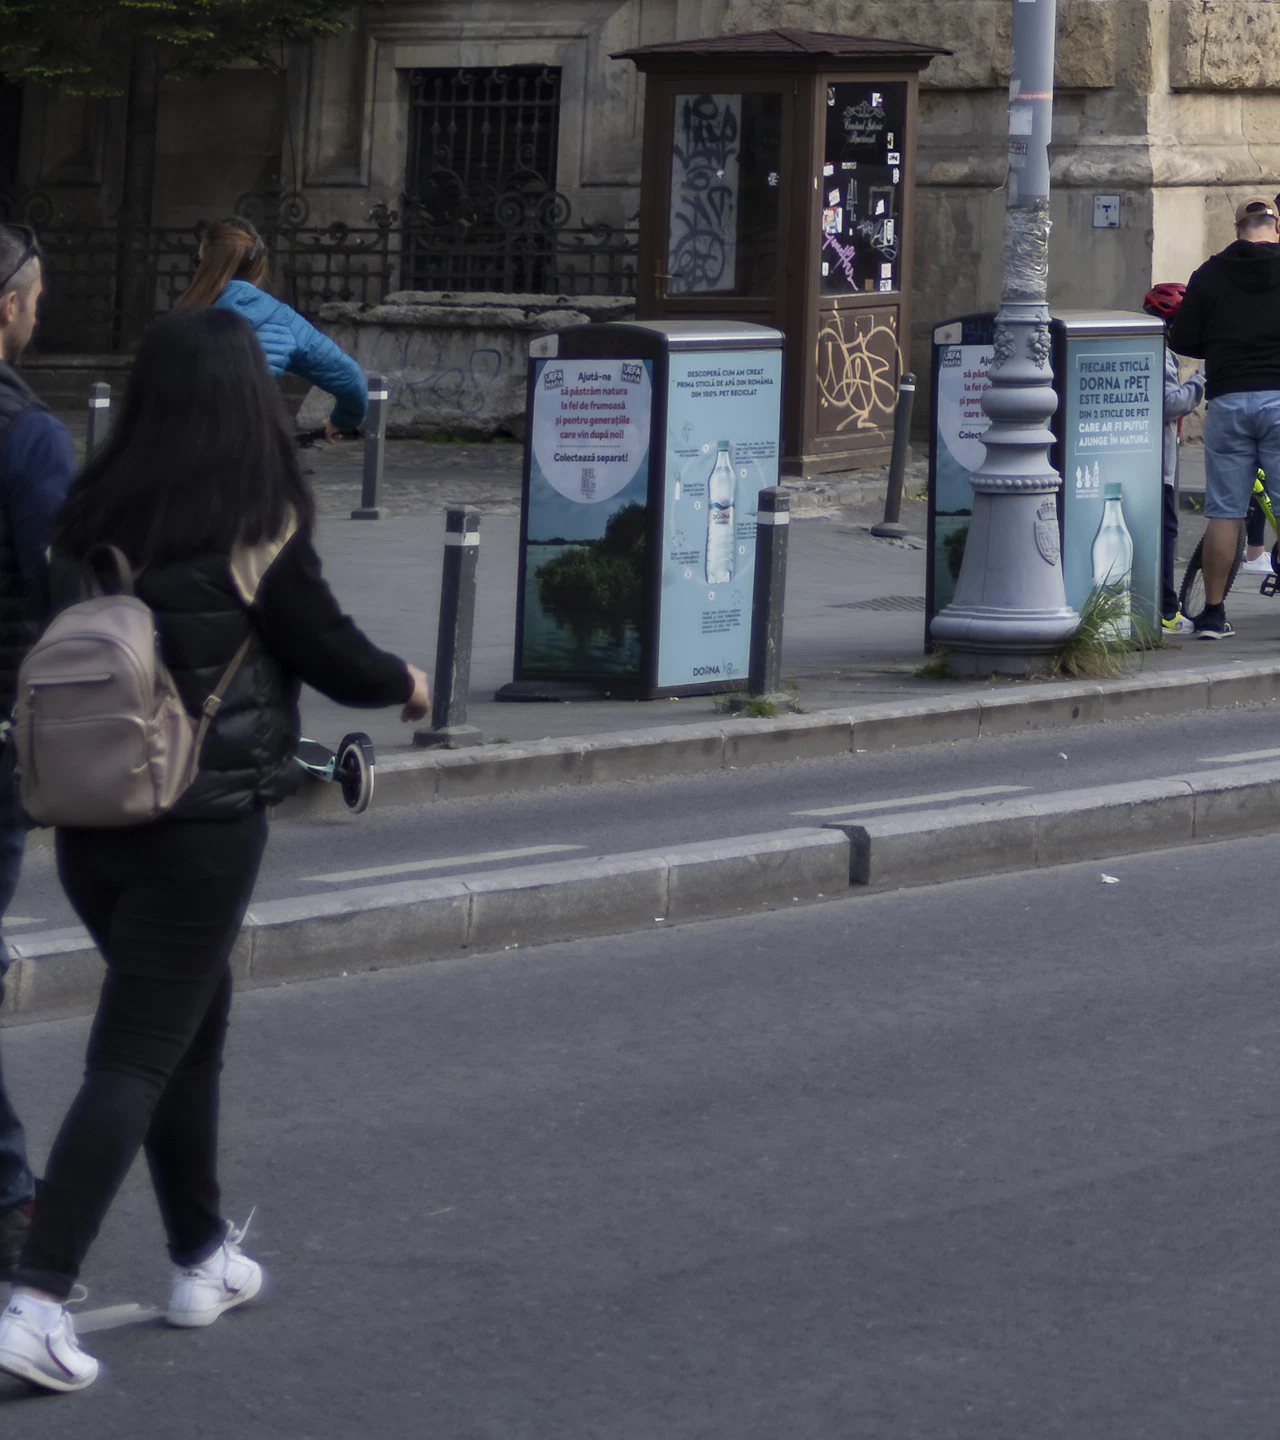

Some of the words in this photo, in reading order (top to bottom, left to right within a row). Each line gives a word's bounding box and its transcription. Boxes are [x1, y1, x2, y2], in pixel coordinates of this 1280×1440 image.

[1080, 362, 1117, 372] FIECARE
[1119, 357, 1150, 372] STICLĂ
[578, 372, 612, 383] Ajută-ne
[687, 368, 721, 378] DESCOPERĂ
[746, 368, 764, 376] CREAT
[695, 378, 715, 388] STICLĂ
[972, 383, 981, 391] fel
[1079, 377, 1121, 391] DORNA
[1124, 375, 1150, 389] rPET
[560, 387, 569, 395] să
[570, 387, 602, 397] păstrăm
[602, 387, 628, 395] natura
[702, 390, 718, 398] 100%
[1079, 394, 1101, 405] ESTE
[1103, 389, 1150, 404] REALIZATĂ
[561, 401, 568, 410] la
[569, 401, 579, 410] fel
[580, 401, 589, 410] de
[590, 401, 626, 410] frumoasă
[1079, 410, 1092, 419] DIN
[1093, 409, 1099, 419] 2
[1100, 409, 1124, 418] STICLE
[1125, 409, 1135, 417] DE
[1136, 408, 1150, 417] PET
[563, 417, 588, 426] pentru
[1079, 423, 1100, 433] CARE
[1101, 422, 1113, 432] AR
[1114, 421, 1122, 431] FI
[1123, 420, 1150, 430] PUTUT
[560, 431, 576, 439] care
[577, 430, 589, 439] vin
[590, 430, 609, 440] după
[610, 430, 624, 439] noi!
[1079, 436, 1108, 447] AJUNGE
[1109, 433, 1118, 445] ÎN
[554, 452, 596, 462] Colectează
[597, 453, 628, 464] separat!
[693, 666, 720, 677] DORNA
